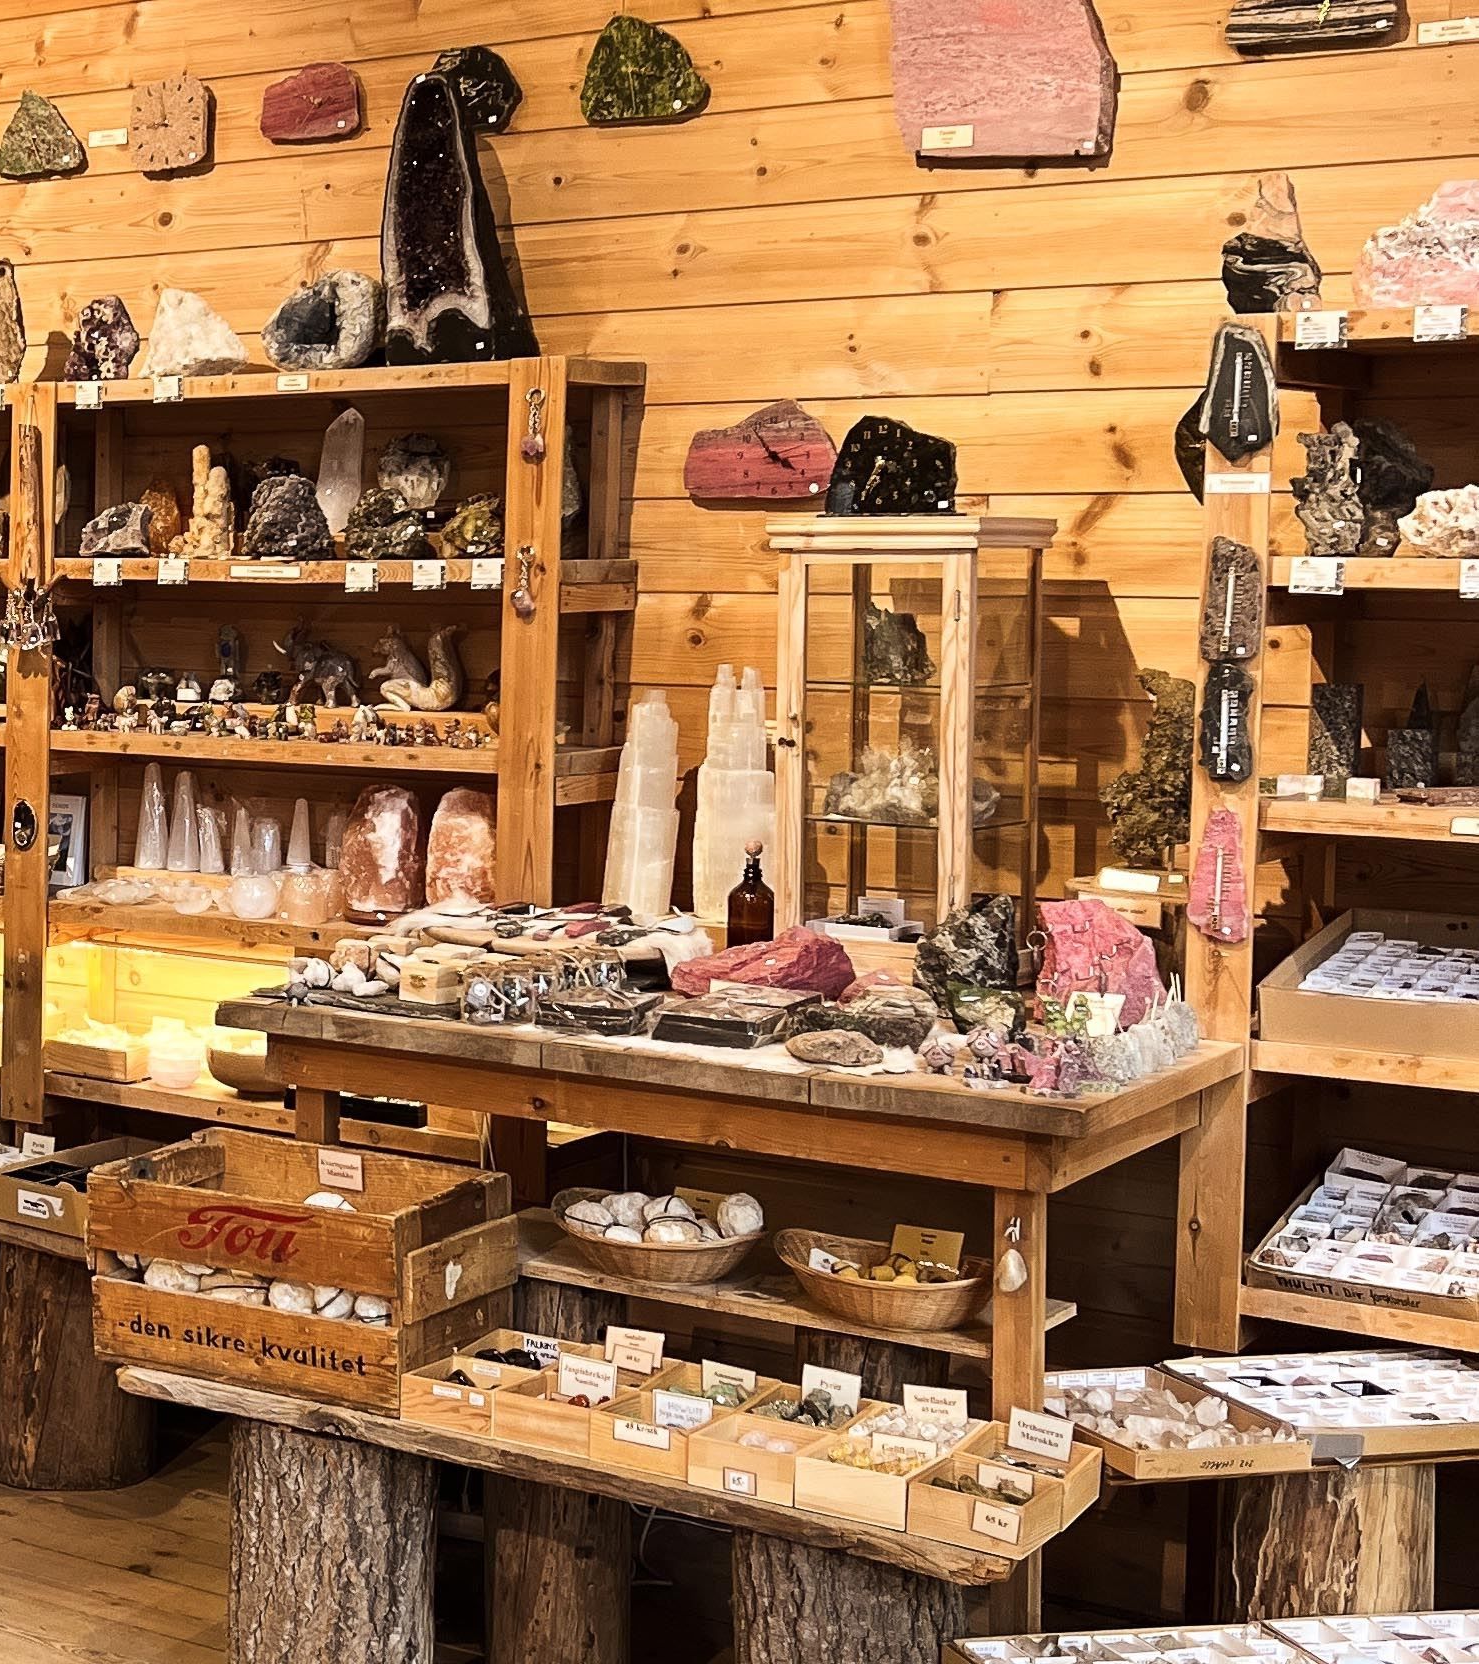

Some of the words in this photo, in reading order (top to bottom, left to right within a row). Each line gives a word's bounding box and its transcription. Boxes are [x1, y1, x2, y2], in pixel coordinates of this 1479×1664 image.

[177, 1204, 315, 1264] Tou
[182, 1325, 245, 1353] sikre
[261, 1336, 367, 1376] kvalitet
[1017, 1419, 1064, 1439] Orthoceras
[1020, 1431, 1059, 1449] Marokko
[998, 1516, 1009, 1529] kr
